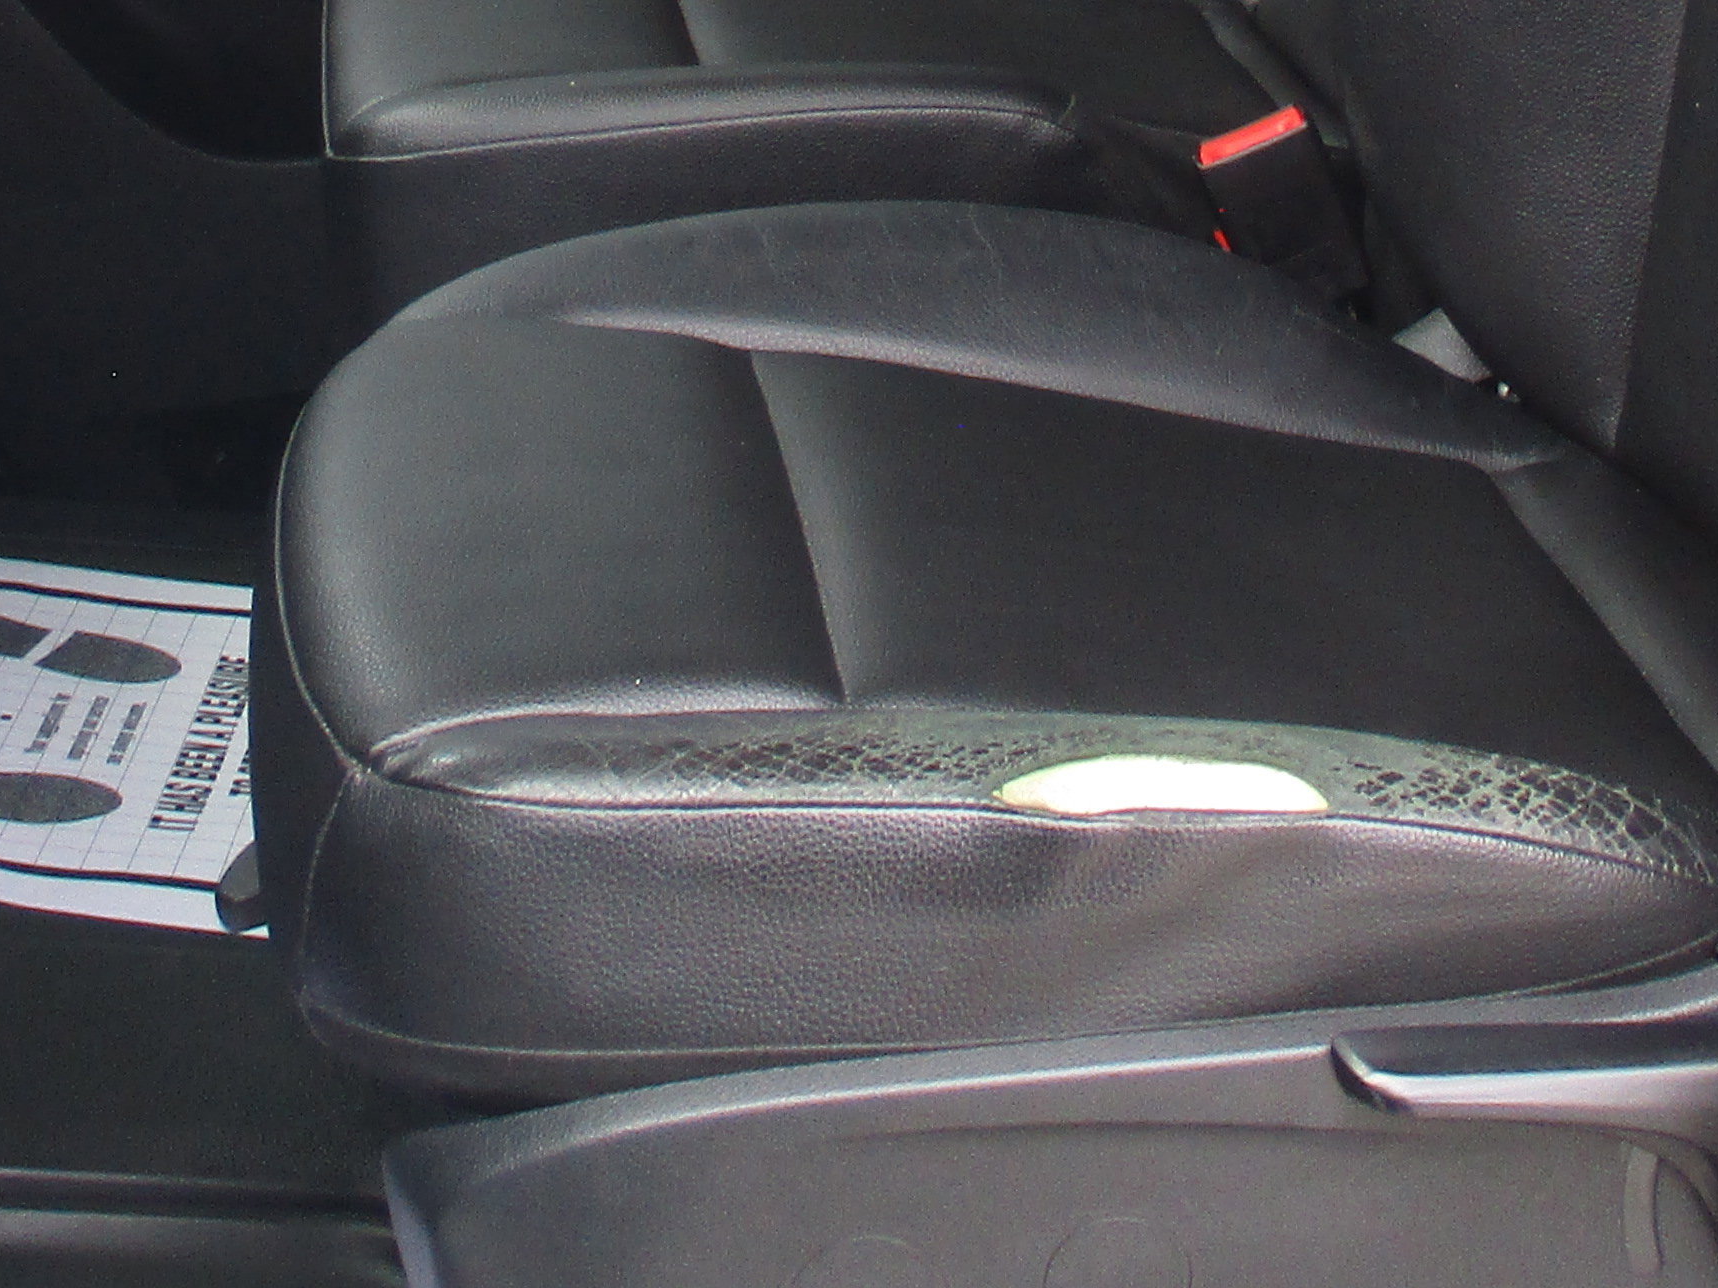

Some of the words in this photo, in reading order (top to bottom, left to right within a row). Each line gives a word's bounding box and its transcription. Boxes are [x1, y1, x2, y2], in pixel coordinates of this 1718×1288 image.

[194, 655, 250, 728] PLEASURE
[188, 729, 235, 742] A
[170, 741, 230, 782] BEEN
[157, 782, 213, 814] HAS
[147, 815, 199, 832] IT
